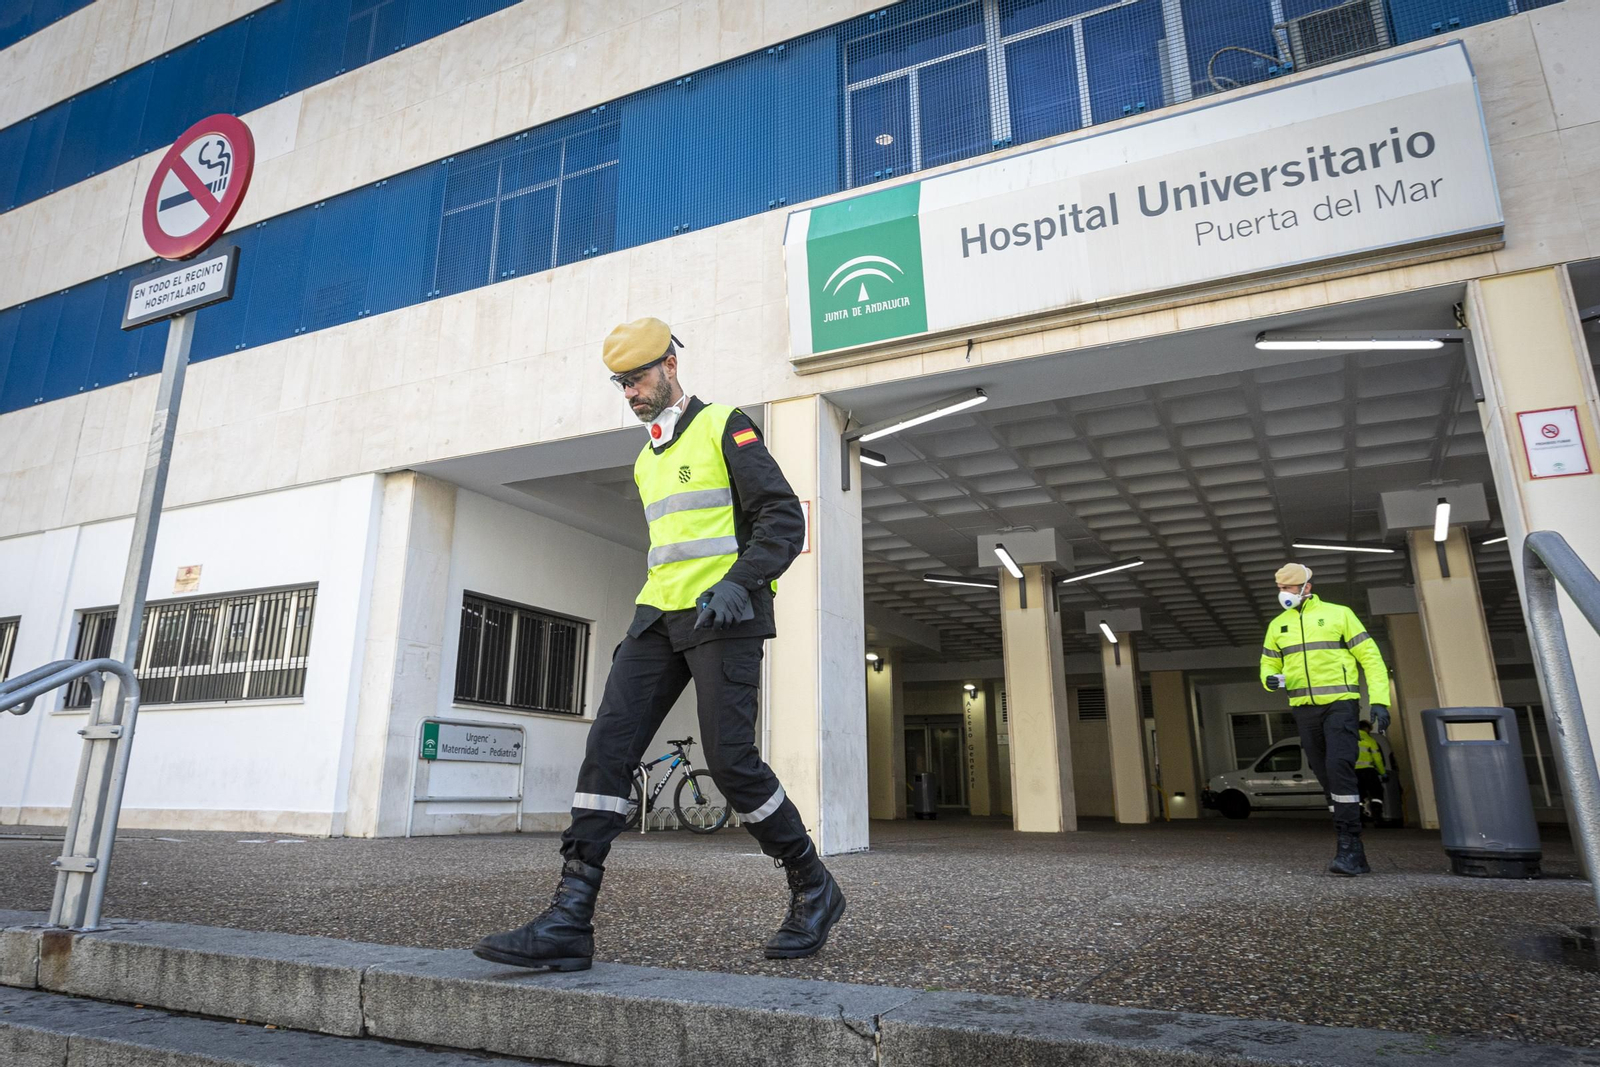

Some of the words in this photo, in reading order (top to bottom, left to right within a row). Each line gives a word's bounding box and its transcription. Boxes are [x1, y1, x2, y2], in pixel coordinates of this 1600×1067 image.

[960, 192, 1119, 258] Hospital
[1138, 126, 1436, 217] Universitario
[1195, 208, 1299, 246] Puerta
[1313, 189, 1361, 222] del
[1375, 177, 1443, 209] Mar
[134, 287, 146, 300] EN
[148, 279, 171, 295] TODO
[172, 275, 182, 287] EL
[184, 262, 224, 283] RECINTO
[144, 281, 206, 309] HOSPITALARIO
[823, 309, 849, 323] JUNTA
[852, 306, 863, 317] DE
[865, 296, 911, 314] ANDALUCIA
[441, 743, 479, 755] Maternidad
